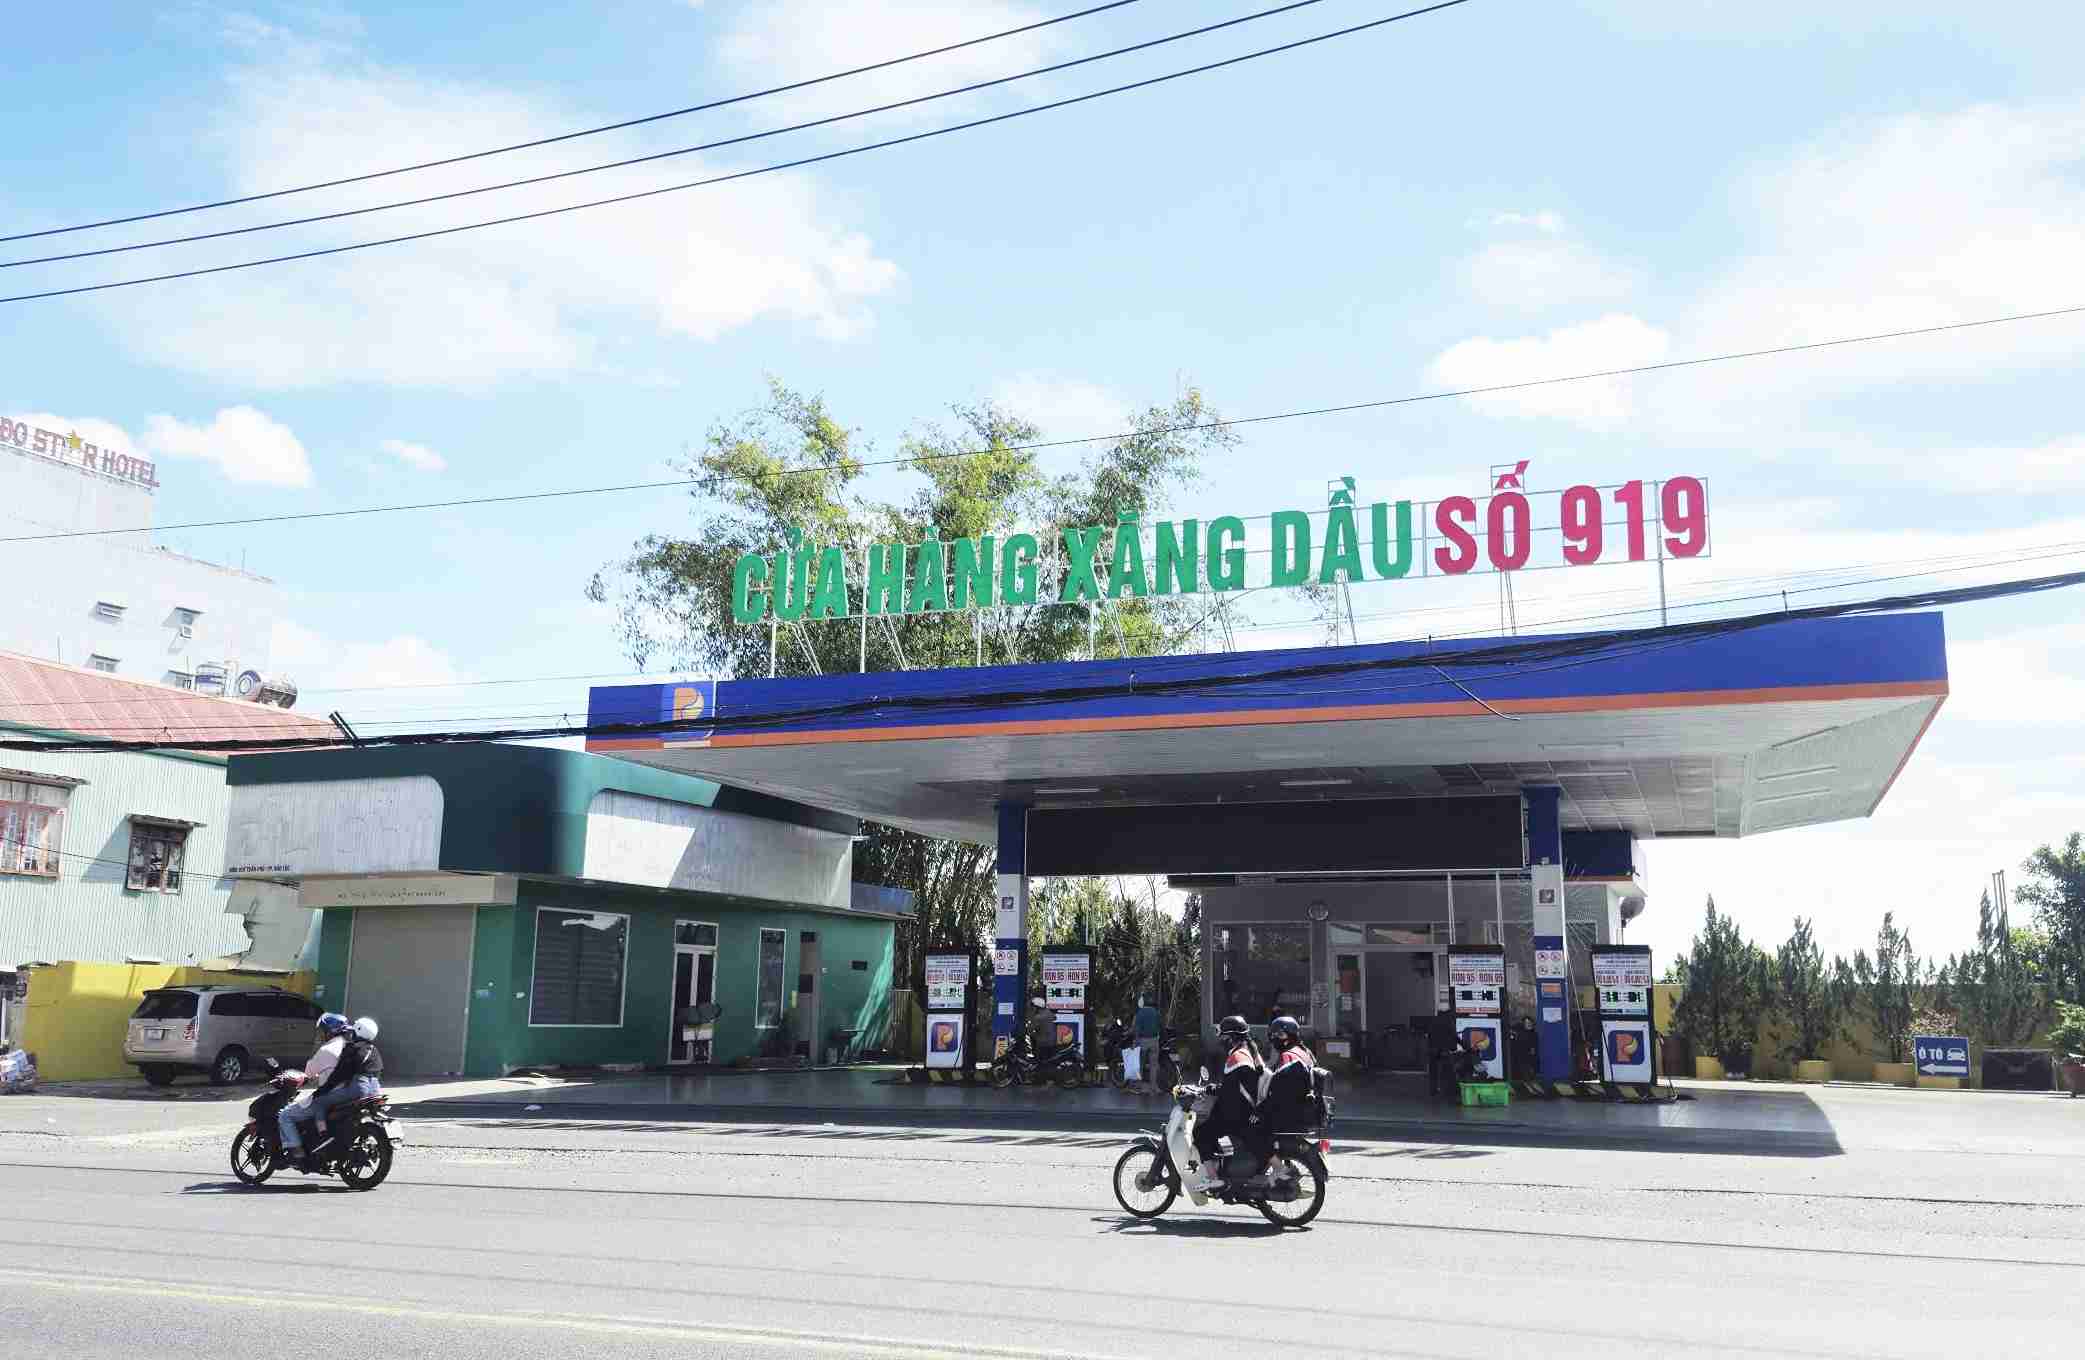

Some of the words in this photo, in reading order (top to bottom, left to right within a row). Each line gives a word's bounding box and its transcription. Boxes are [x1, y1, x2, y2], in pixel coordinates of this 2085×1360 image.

[102, 448, 159, 486] HOTEL
[732, 524, 849, 624] CỬA
[867, 527, 1038, 616] HÀNG
[1060, 511, 1245, 602] XĂNG
[1271, 476, 1412, 588] DẦU
[1434, 460, 1530, 575] SỐ
[1560, 476, 1707, 566] 919
